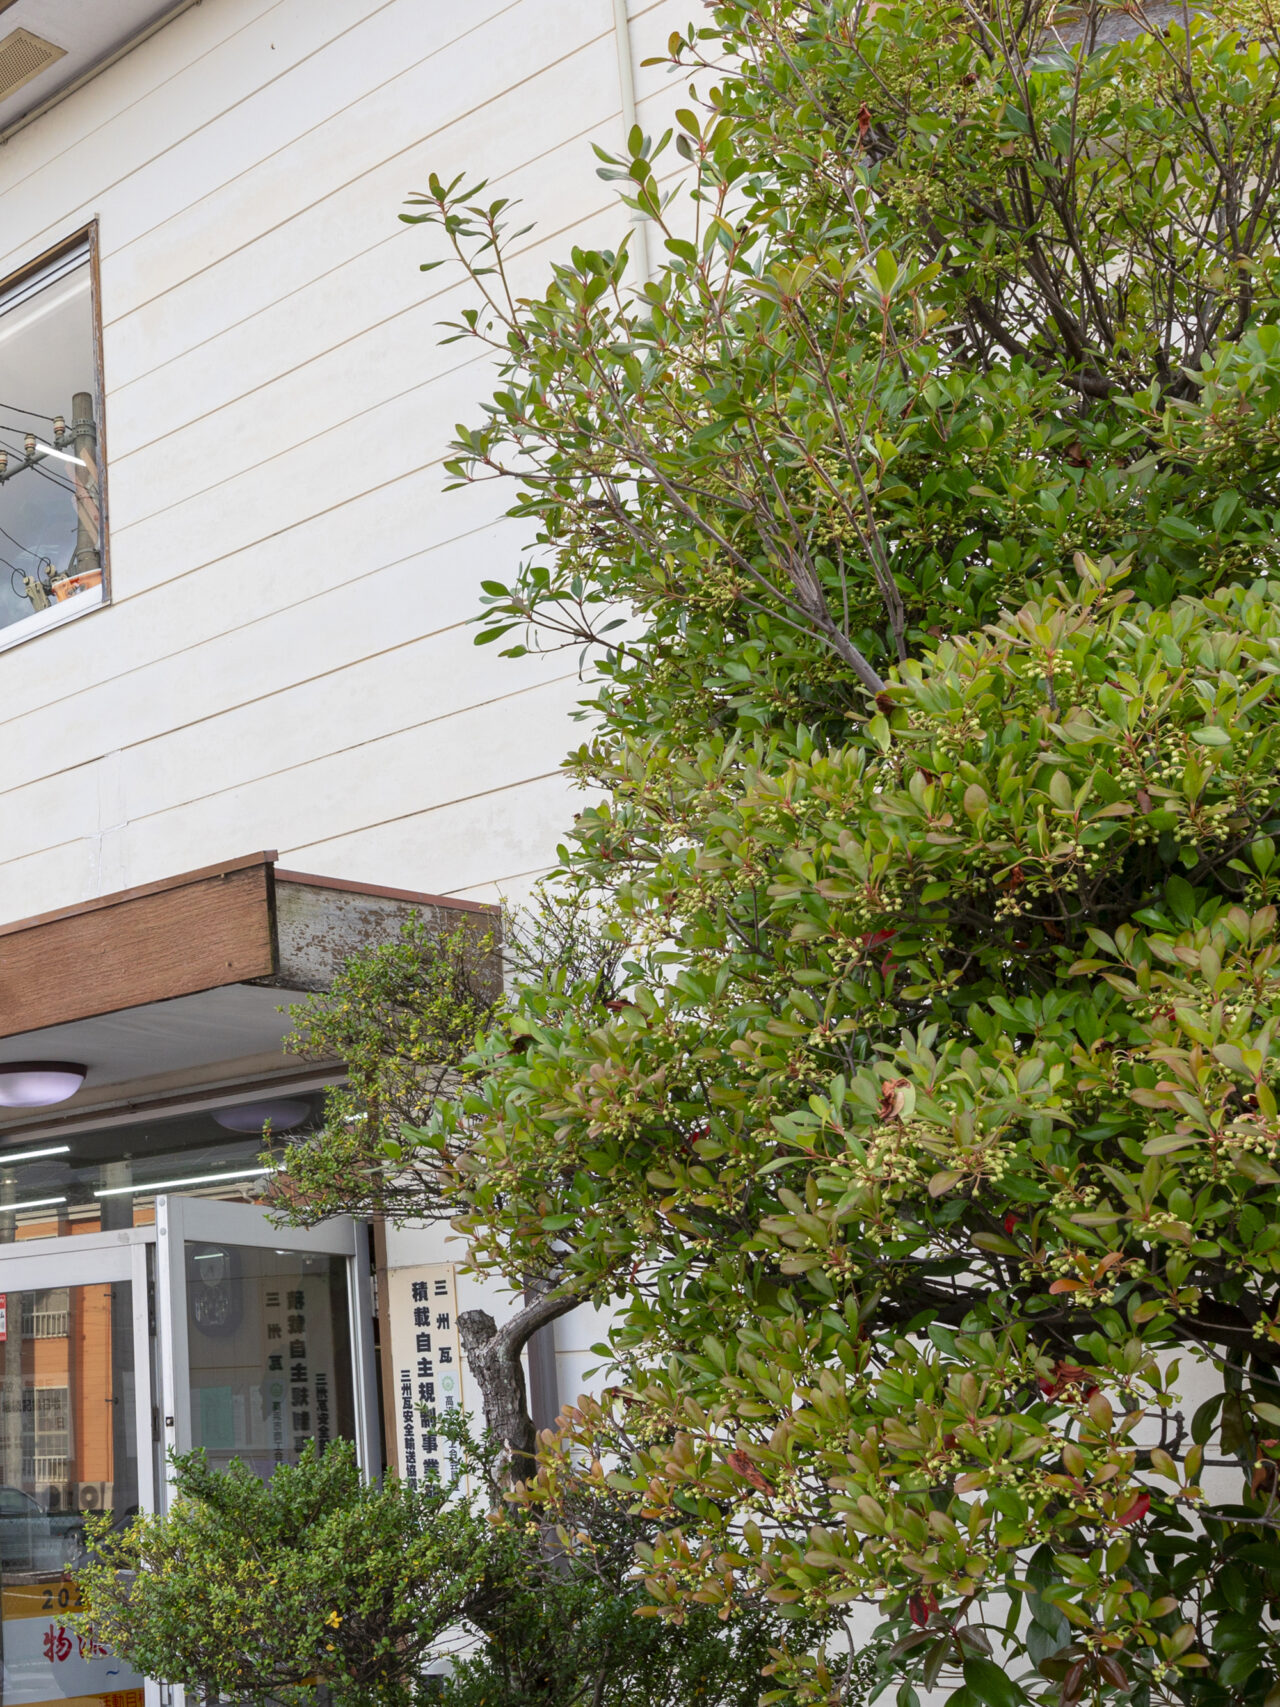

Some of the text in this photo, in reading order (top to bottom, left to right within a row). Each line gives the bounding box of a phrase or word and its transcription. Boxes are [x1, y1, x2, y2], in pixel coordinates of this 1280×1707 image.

[434, 1280, 452, 1364] 三州瓦
[41, 1588, 86, 1610] 202
